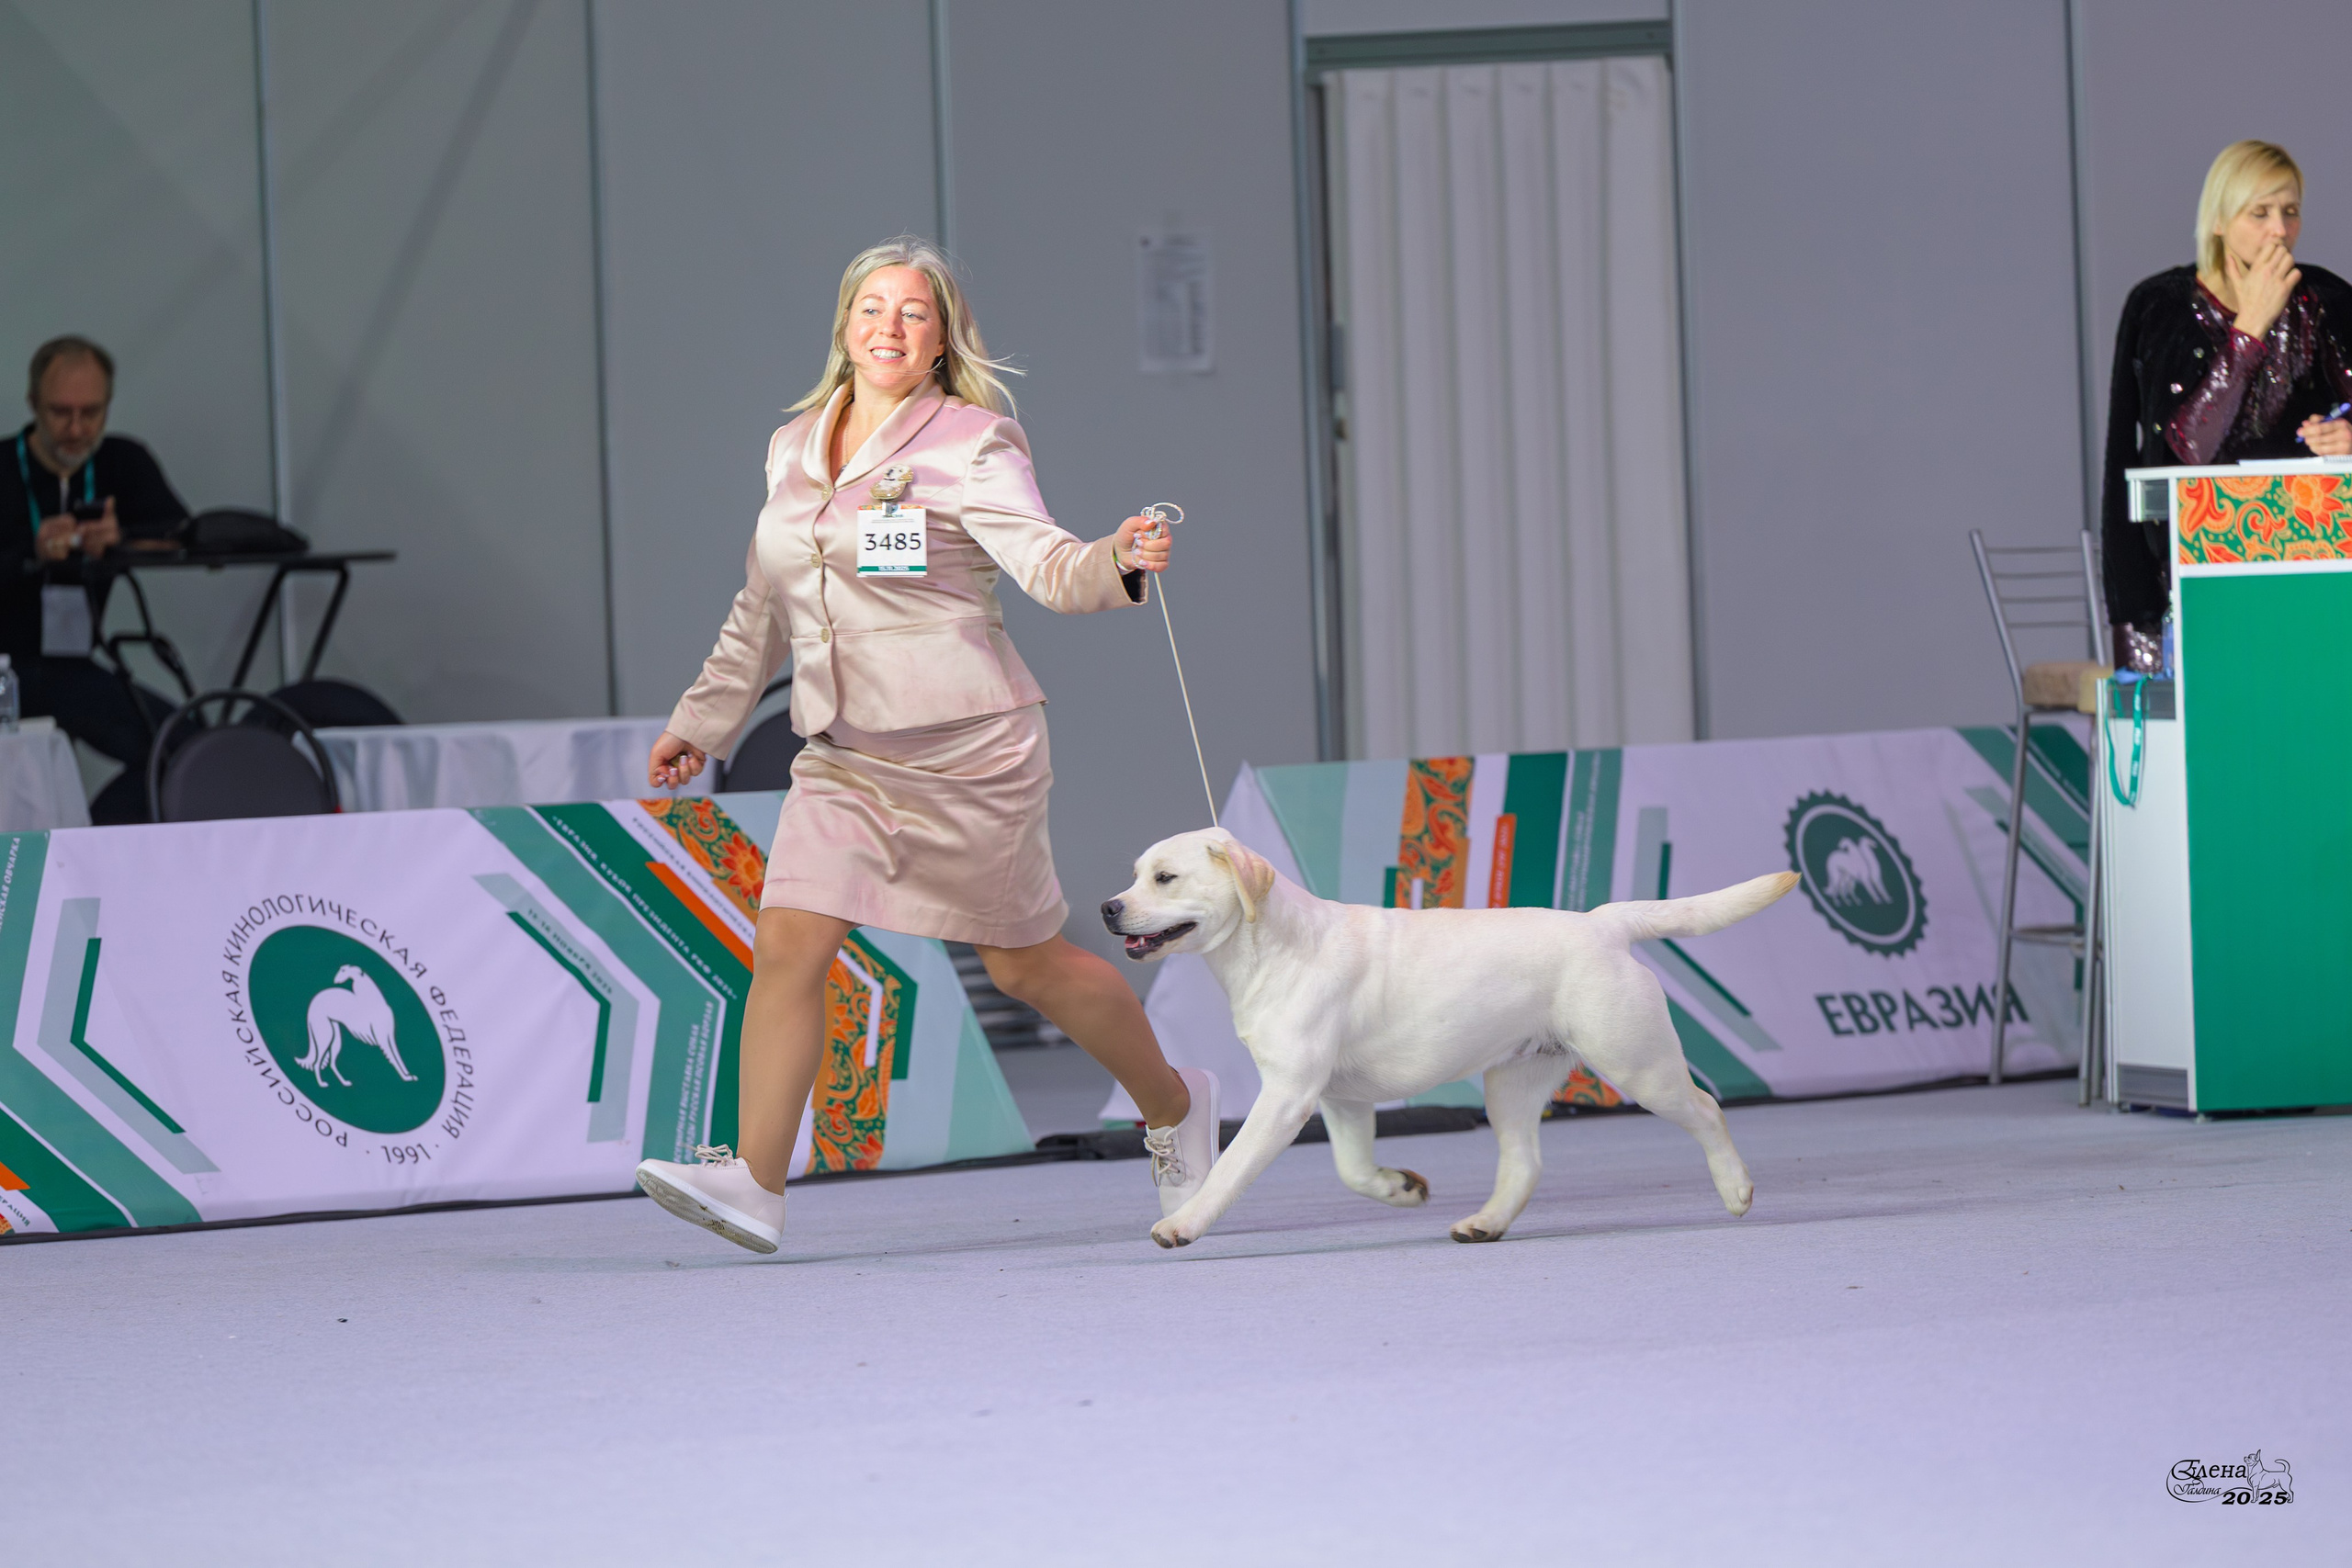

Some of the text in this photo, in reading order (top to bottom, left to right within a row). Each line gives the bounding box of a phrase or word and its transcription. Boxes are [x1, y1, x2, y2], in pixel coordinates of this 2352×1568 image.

[865, 532, 922, 550] 3485
[4, 837, 20, 884] ОВЧАРКА
[632, 892, 690, 954] ПРЕЗИДЕНТА
[691, 953, 712, 975] РКФ
[221, 894, 474, 1147] РОССИЙСКАЯ КИНОЛОГИЧЕСКАЯ ФЕДЕРАЦИЯ
[1815, 979, 2030, 1037] ЕВРАЗИЯ
[679, 1057, 694, 1108] ВЫСТАВКА
[688, 1024, 699, 1056] СОБАК
[380, 1145, 432, 1165] 1991
